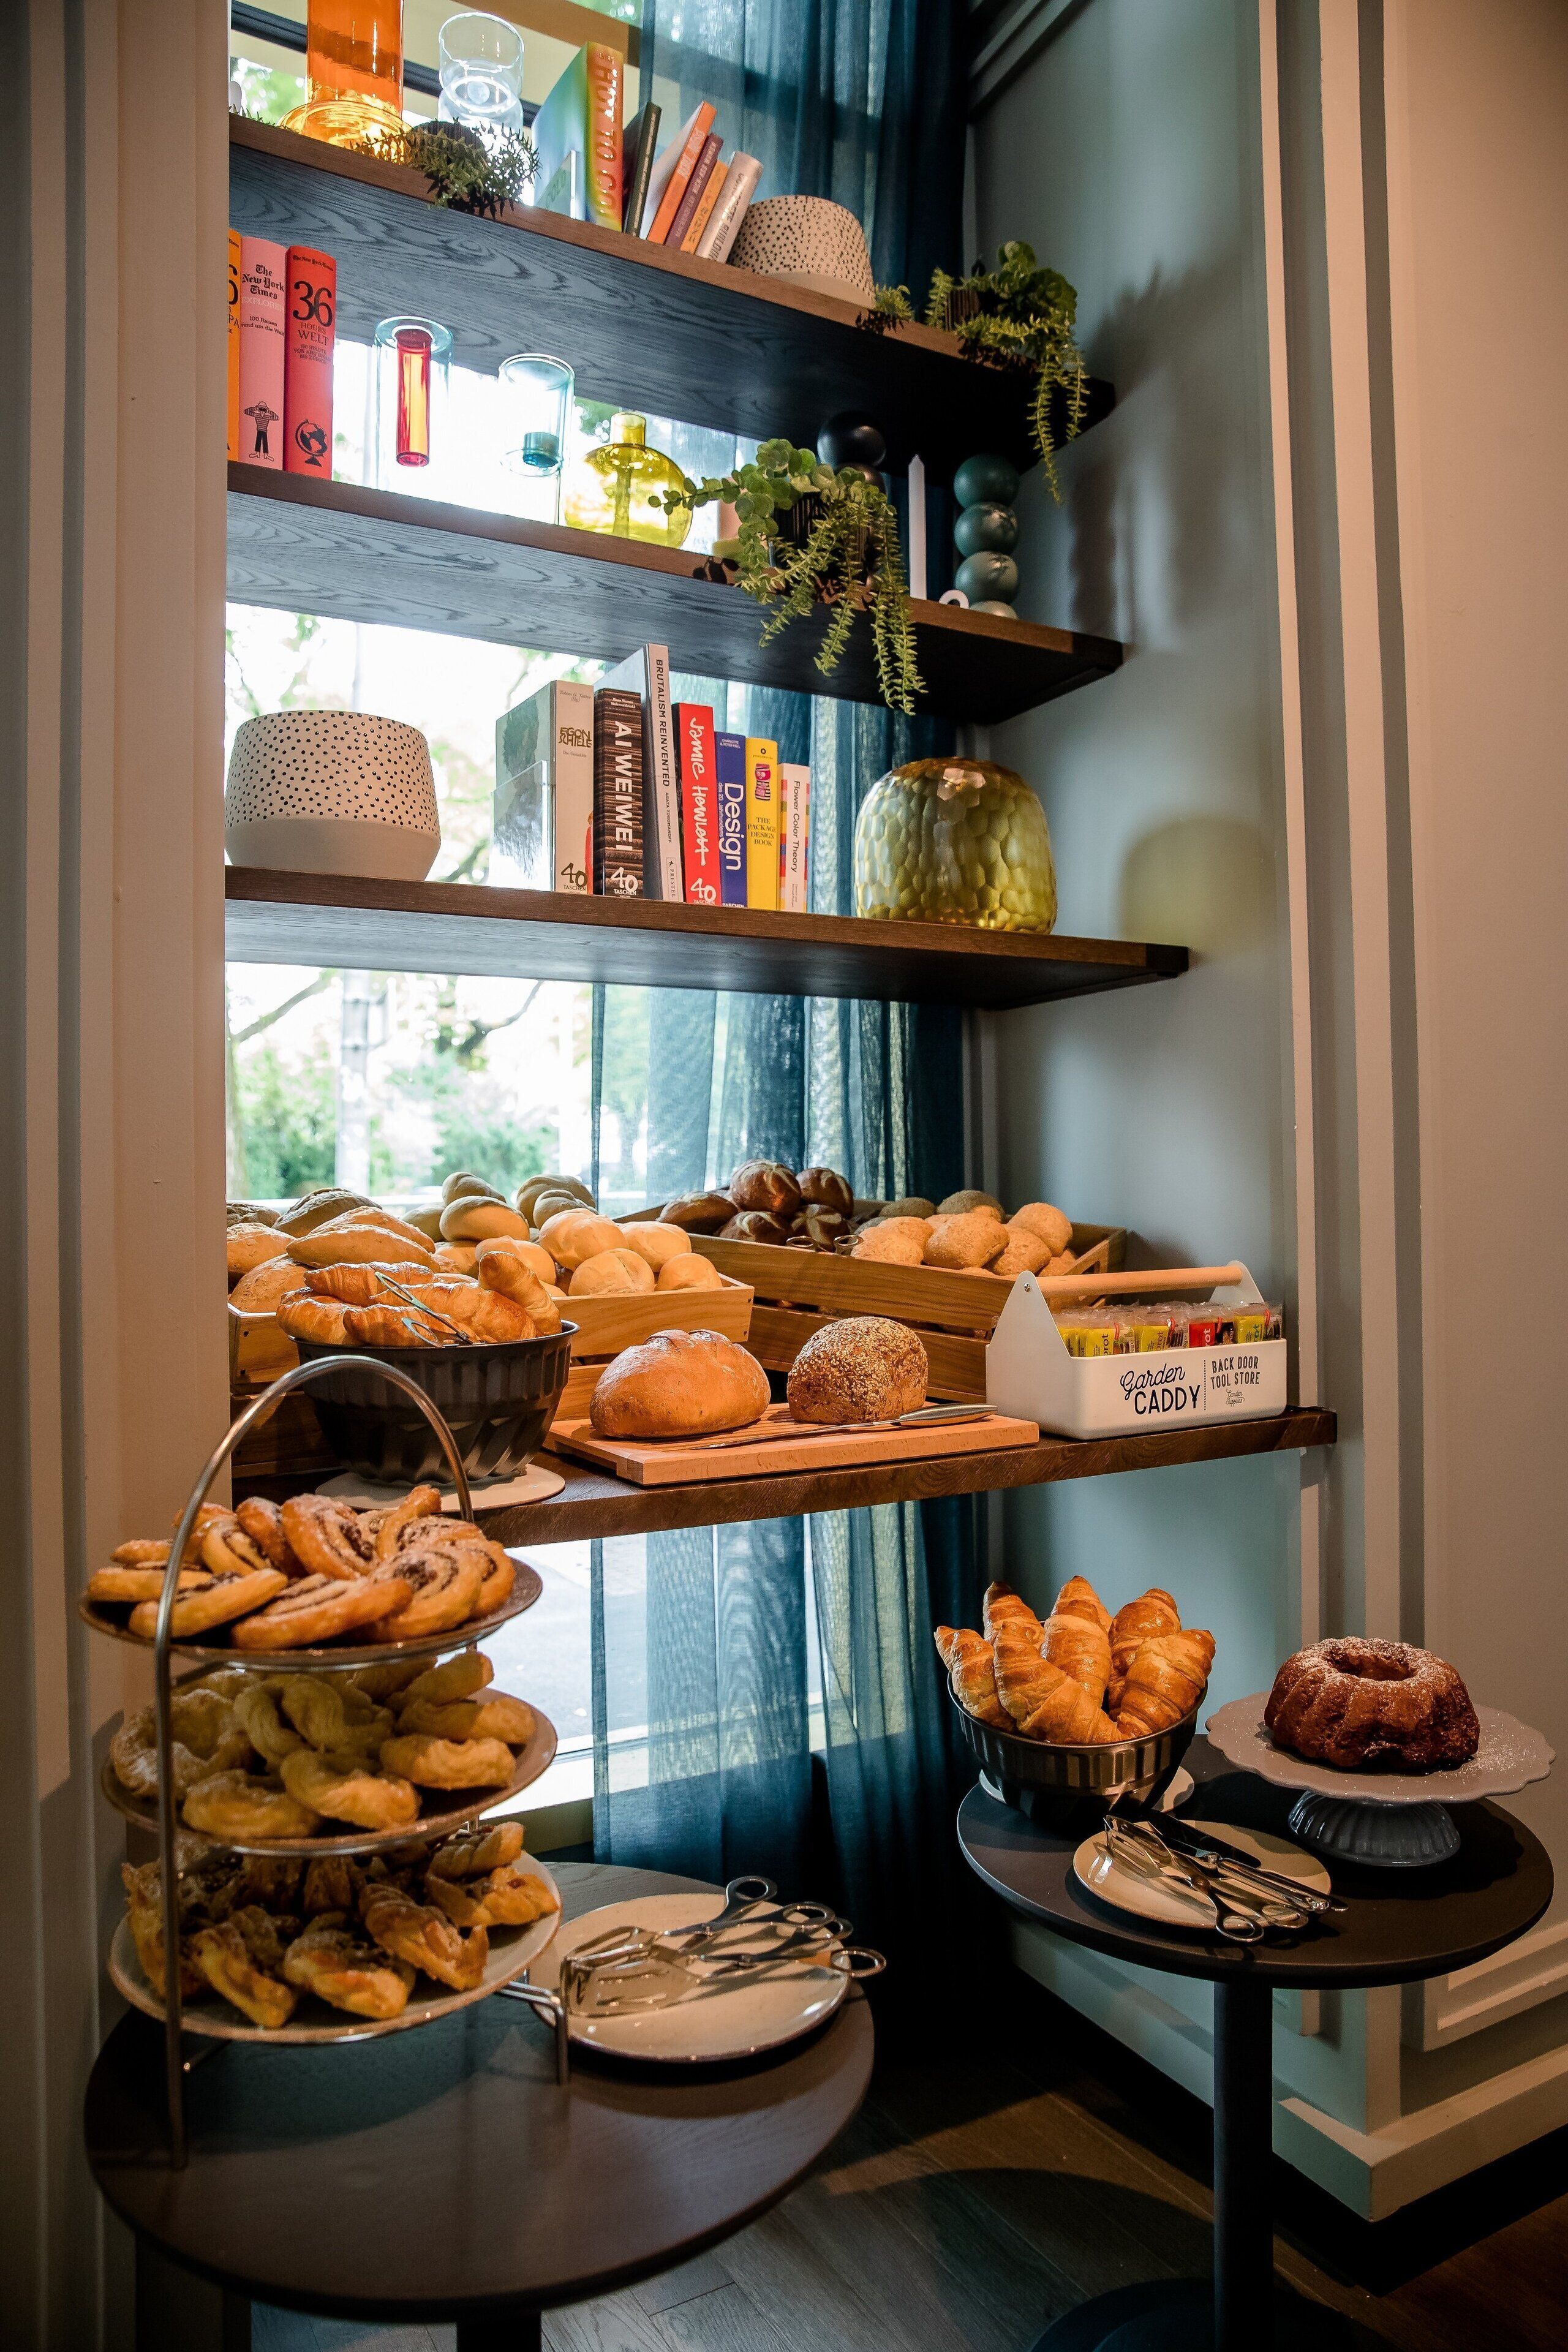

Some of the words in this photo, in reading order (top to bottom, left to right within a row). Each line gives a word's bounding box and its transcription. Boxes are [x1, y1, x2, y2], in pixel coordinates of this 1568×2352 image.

[255, 264, 273, 276] The
[241, 273, 262, 284] New
[263, 279, 285, 292] York
[250, 284, 278, 300] Times
[293, 281, 333, 327] 36
[297, 329, 329, 345] WELT
[656, 658, 667, 718] BRUTALISM
[558, 734, 592, 748] SCHIELE
[560, 727, 590, 740] EGON
[615, 720, 632, 747] AI
[660, 721, 670, 787] REINVENTED
[615, 754, 633, 851] WEIWEI
[718, 783, 745, 870] Design
[747, 824, 775, 833] PACKAGE
[753, 838, 772, 846] BOOK
[791, 840, 800, 873] Theory
[561, 862, 588, 888] 40
[611, 867, 638, 892] 40
[690, 878, 716, 902] 40
[1212, 1357, 1234, 1374] BACK
[1238, 1355, 1259, 1370] DOOR
[1120, 1363, 1185, 1401] Garden
[1211, 1375, 1231, 1390] TOOL
[1235, 1371, 1261, 1385] STORE
[1134, 1385, 1200, 1415] CADDY
